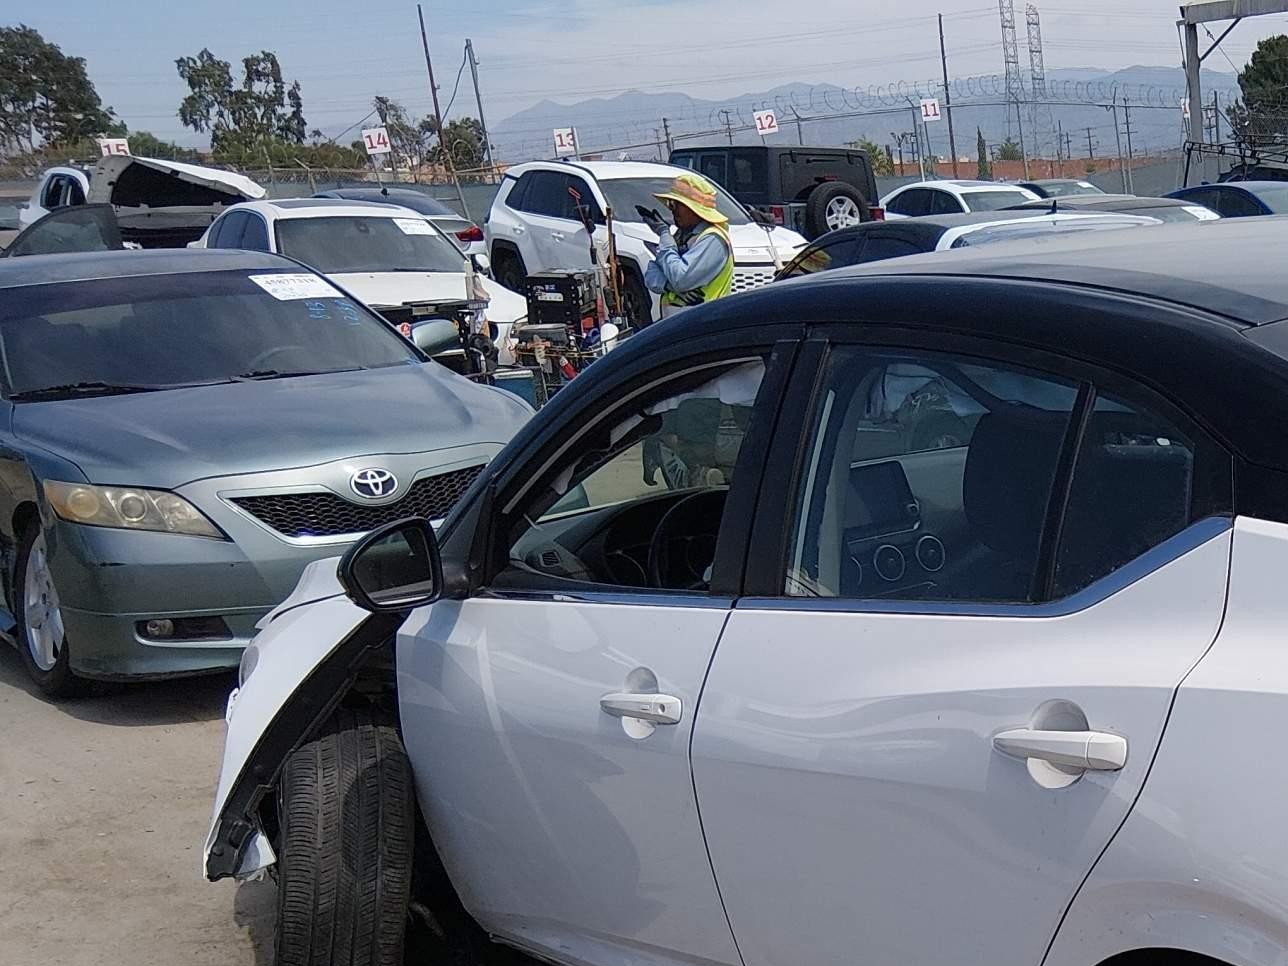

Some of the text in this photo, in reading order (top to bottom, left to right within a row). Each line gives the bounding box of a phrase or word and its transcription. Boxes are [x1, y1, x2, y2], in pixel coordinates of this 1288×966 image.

[922, 103, 939, 117] 11
[756, 114, 777, 130] 12
[365, 132, 388, 149] 14
[556, 133, 575, 147] 13
[103, 143, 129, 155] 15
